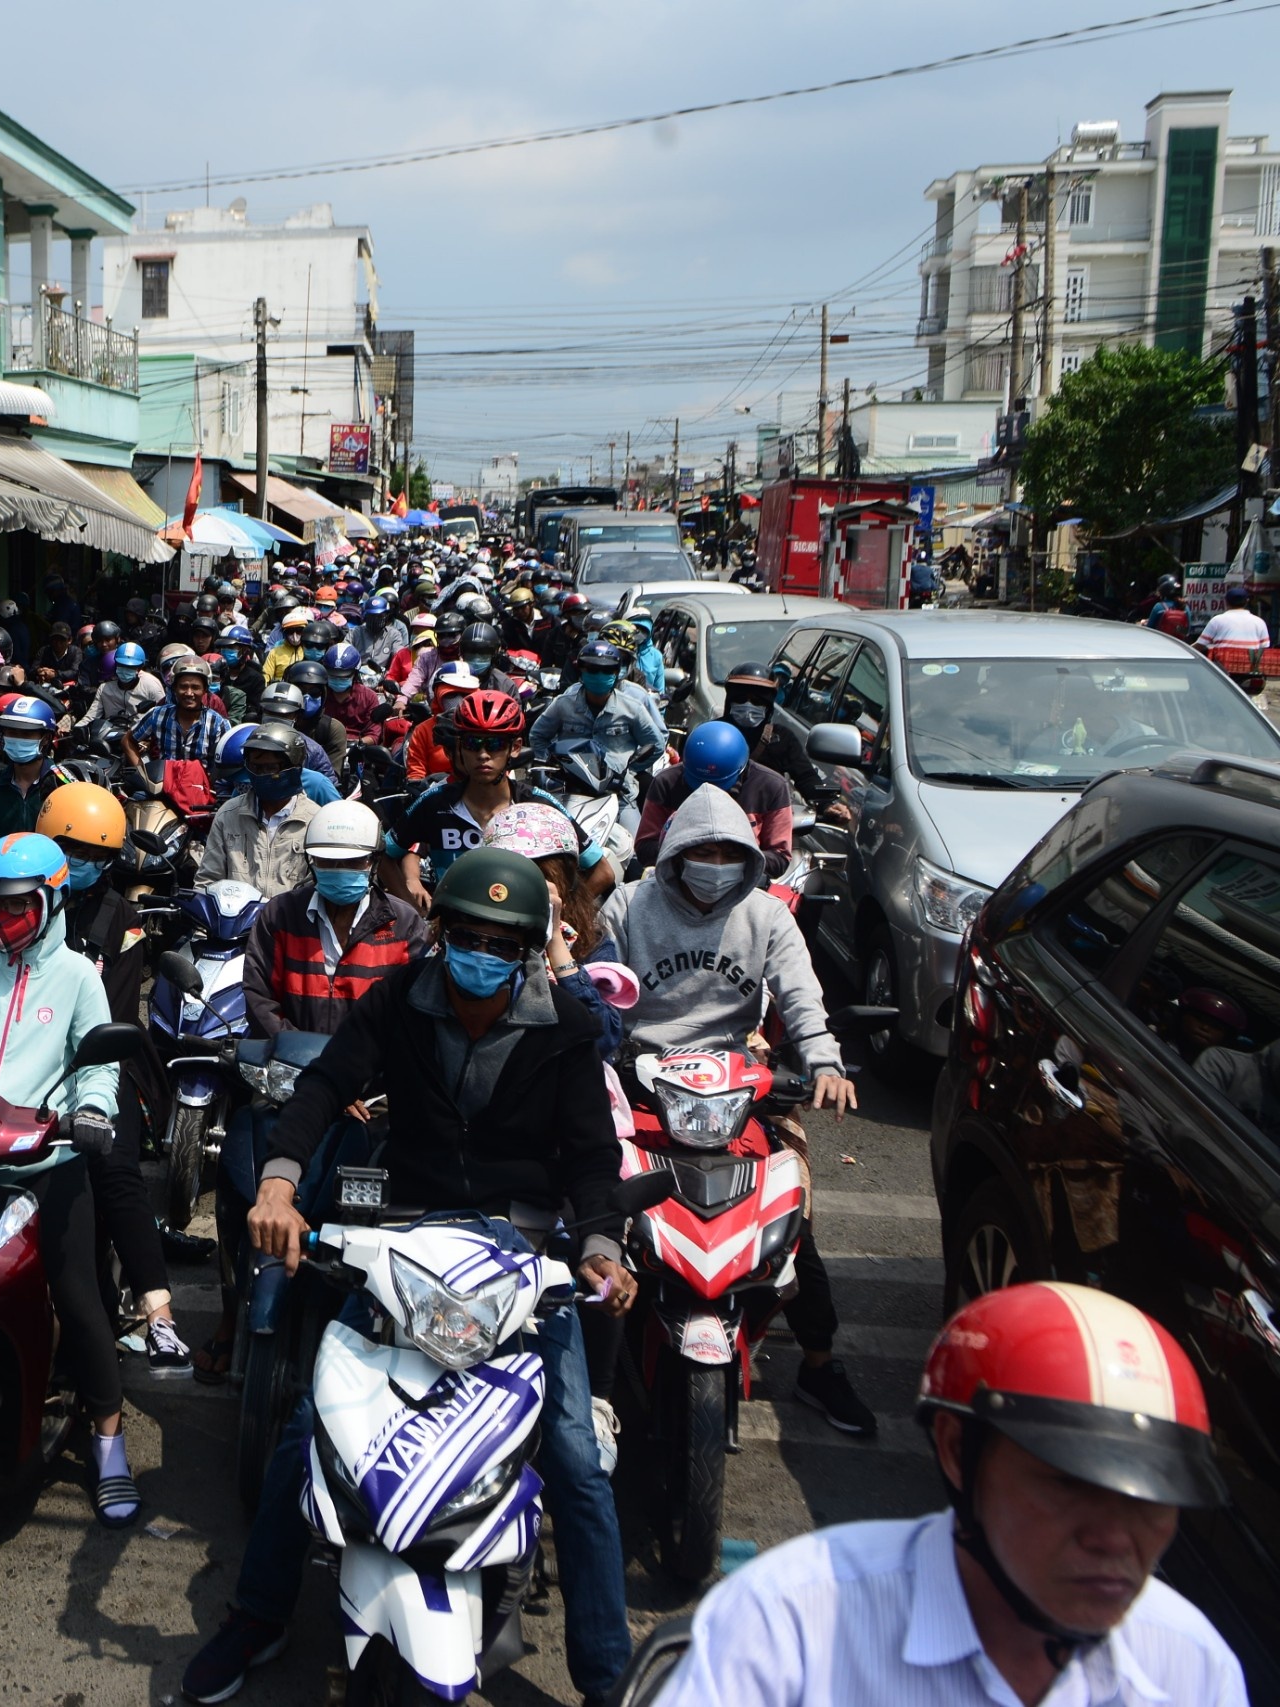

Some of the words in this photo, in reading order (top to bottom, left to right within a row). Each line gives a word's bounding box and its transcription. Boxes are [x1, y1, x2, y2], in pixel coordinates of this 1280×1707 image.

[1186, 583, 1209, 595] MUA
[441, 828, 483, 850] BO
[642, 950, 757, 998] CONVERSE
[374, 1370, 488, 1481] YAMAHA
